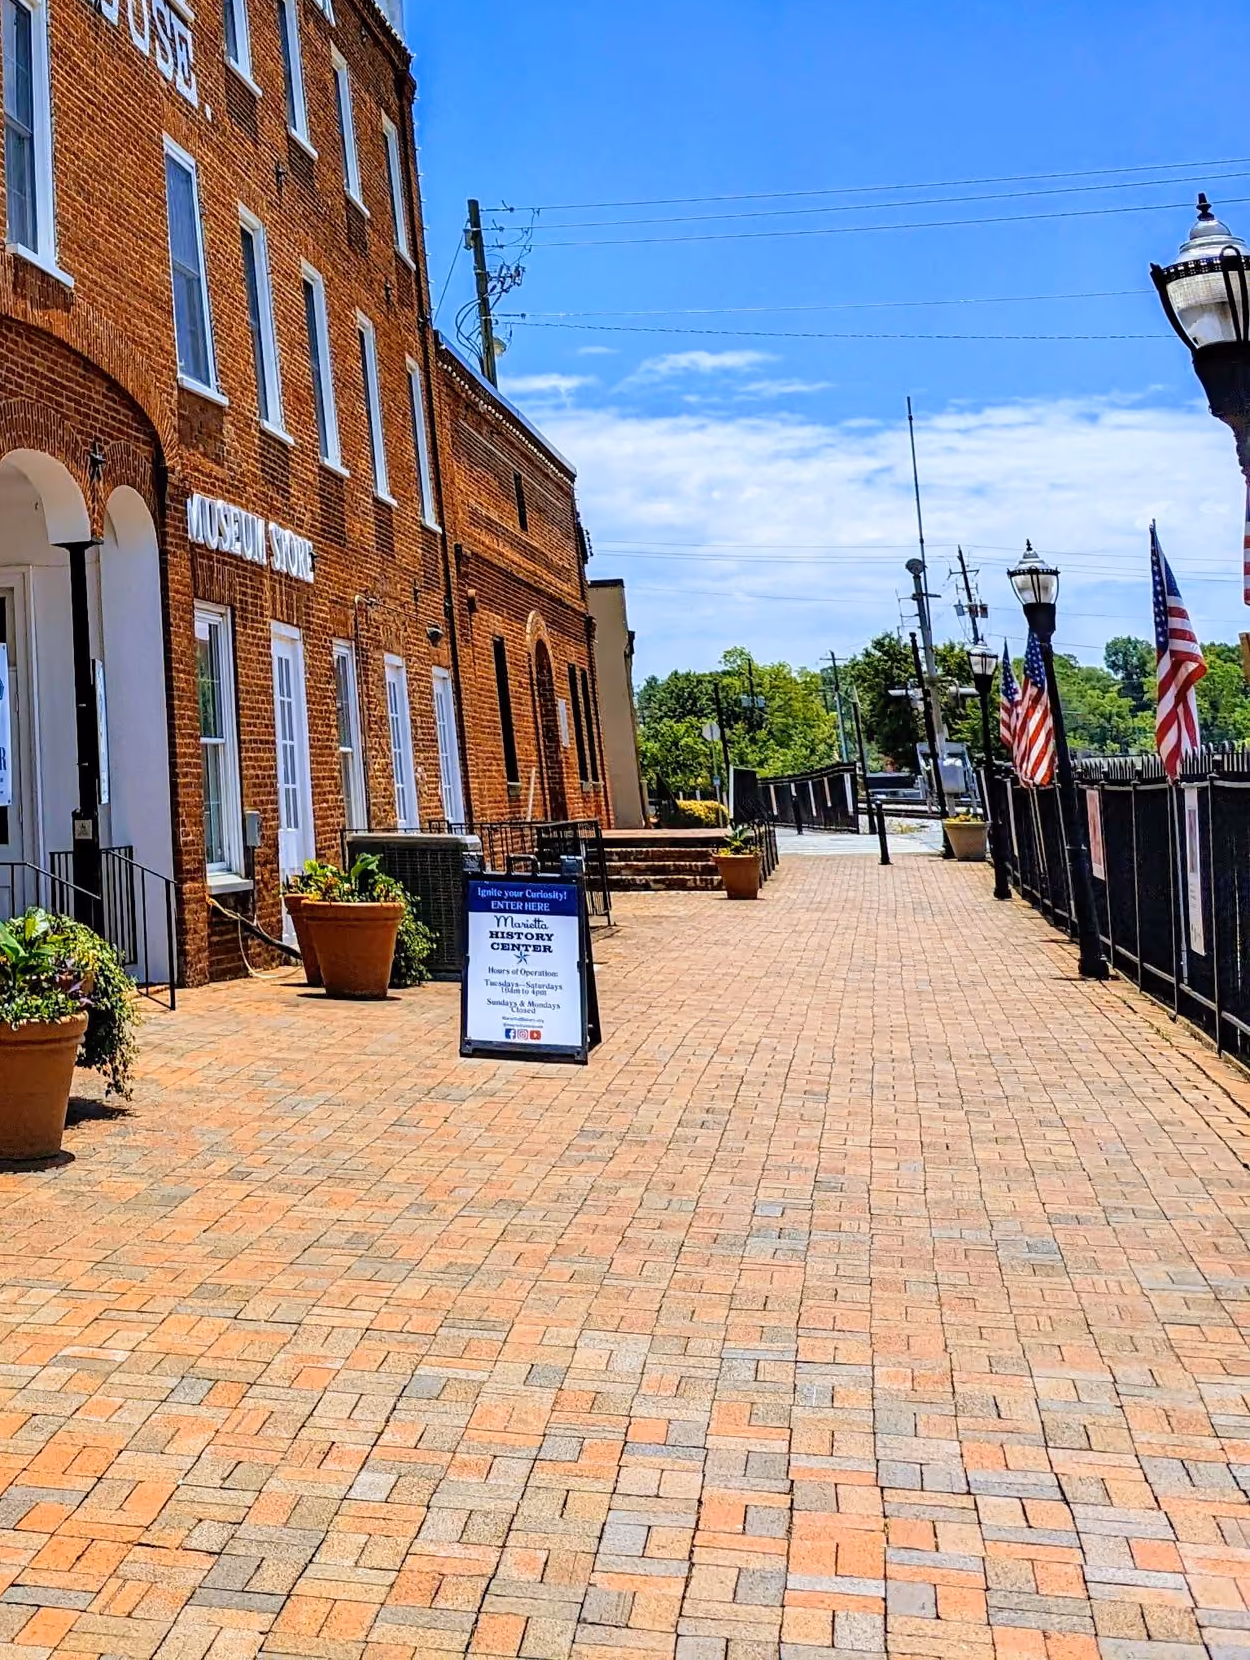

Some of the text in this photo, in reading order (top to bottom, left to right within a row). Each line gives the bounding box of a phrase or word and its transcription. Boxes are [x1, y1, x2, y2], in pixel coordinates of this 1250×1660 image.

[186, 493, 314, 584] MUSEUM STORE
[477, 886, 567, 901] Ignite your Curiosity!
[491, 900, 550, 912] ENTER HERE
[494, 914, 549, 930] Marietta
[489, 930, 554, 941] HISTORY
[490, 942, 553, 953] CENTER
[488, 966, 510, 975] Hours
[519, 967, 559, 978] Operation:
[531, 988, 547, 996] 4pm
[486, 998, 518, 1008] Sundays
[527, 1000, 561, 1010] Mondays
[510, 1006, 536, 1014] Closed
